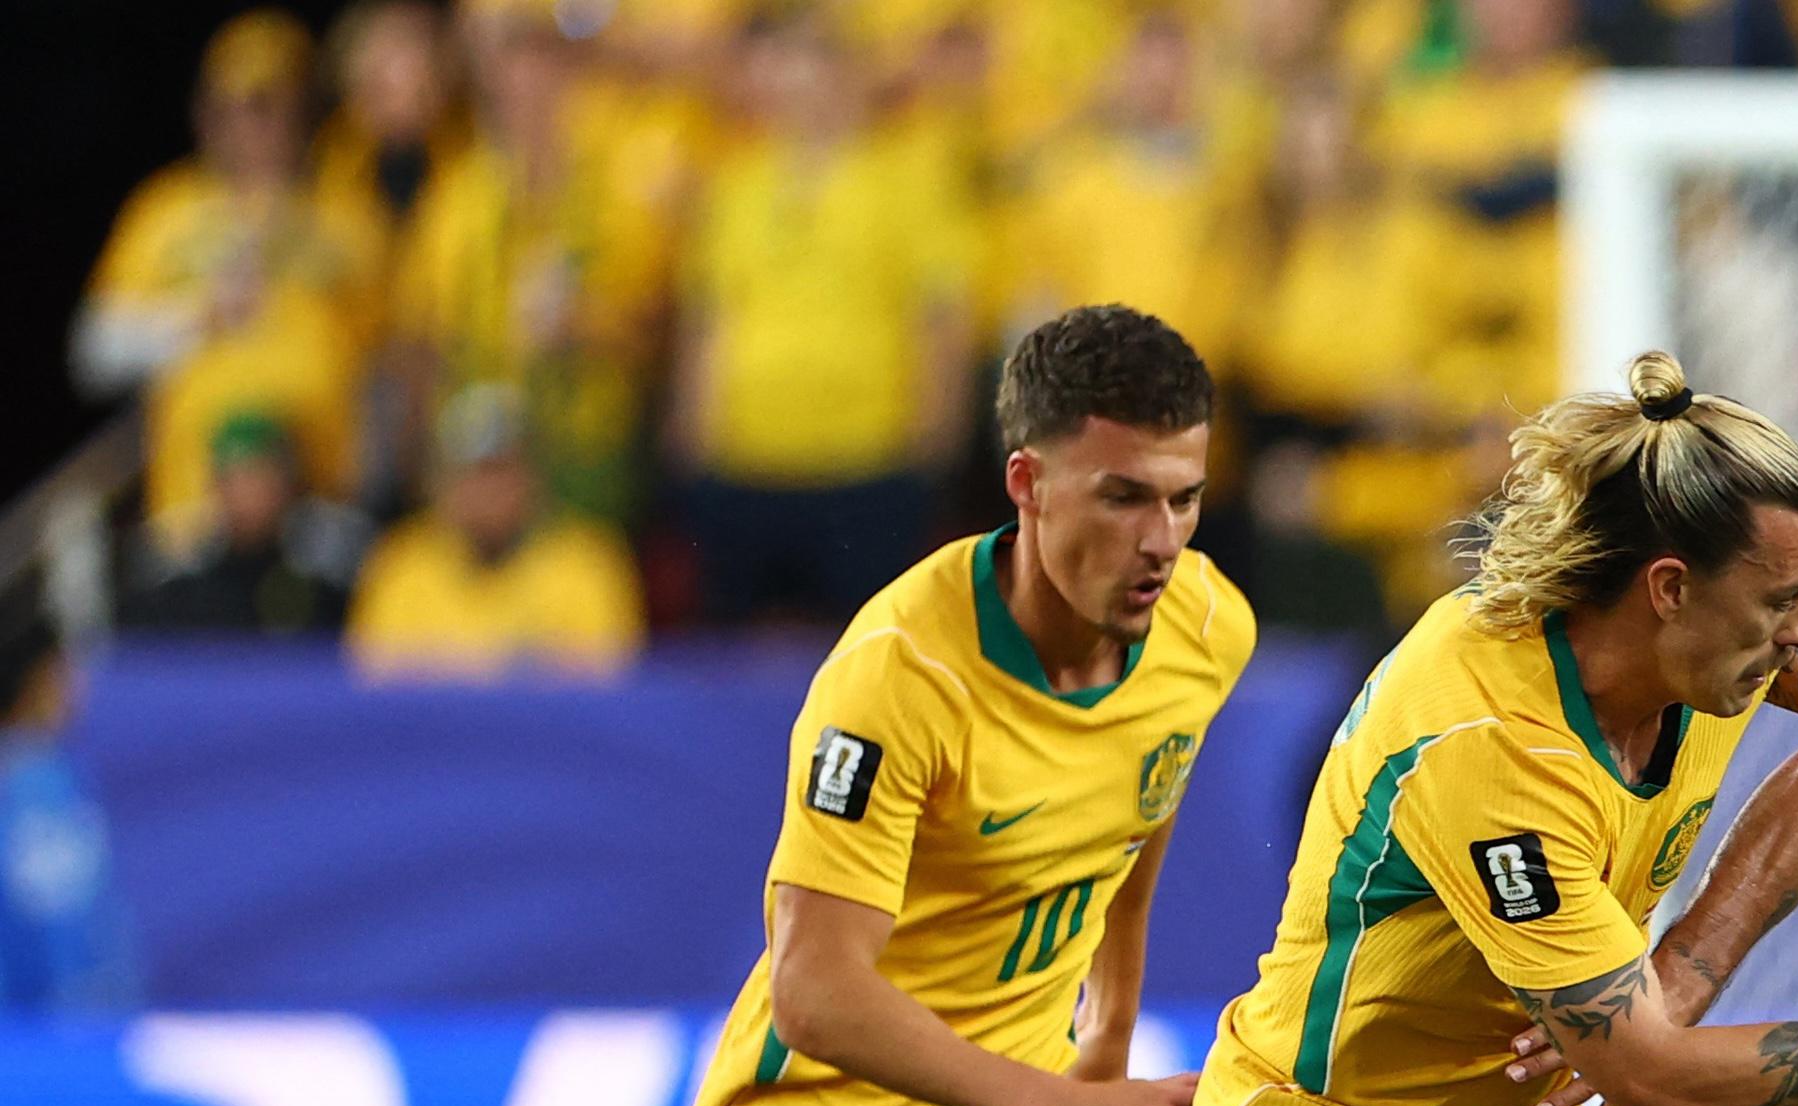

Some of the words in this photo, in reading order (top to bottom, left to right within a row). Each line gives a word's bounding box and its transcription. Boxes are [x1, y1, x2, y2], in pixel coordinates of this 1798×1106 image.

[1507, 888, 1524, 896] FIFA
[1505, 904, 1541, 917] 2026
[997, 879, 1094, 982] 10
